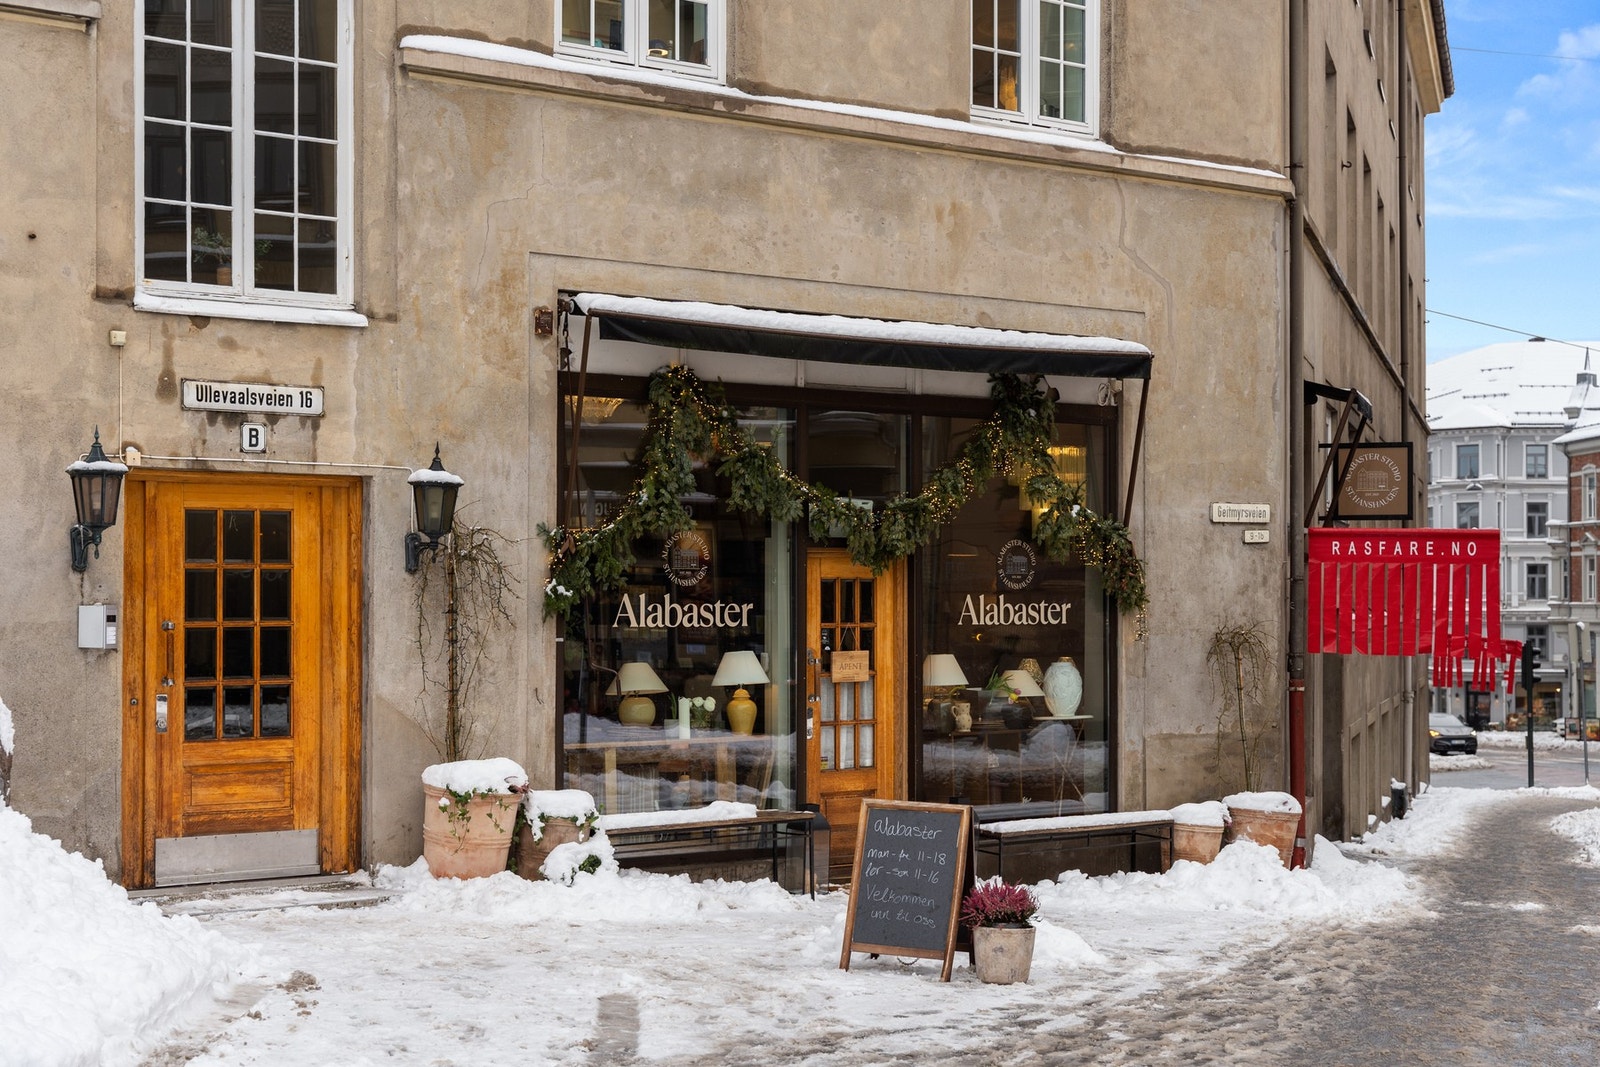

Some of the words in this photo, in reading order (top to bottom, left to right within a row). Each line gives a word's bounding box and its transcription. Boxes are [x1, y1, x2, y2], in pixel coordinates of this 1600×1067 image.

[196, 384, 293, 407] Ullevaalsveien
[299, 390, 313, 408] 16
[248, 427, 259, 448] B
[1380, 455, 1401, 482] STUDIO
[1217, 505, 1267, 521] Geitmyrsveien
[692, 534, 711, 561] STUDIO
[997, 539, 1021, 565] ALABASTER
[1022, 541, 1037, 566] STUDIO
[1332, 541, 1478, 556] RASFARE.NO
[612, 593, 754, 628] Alabaster
[957, 594, 1072, 626] Alabaster
[866, 884, 935, 909] Velkommen
